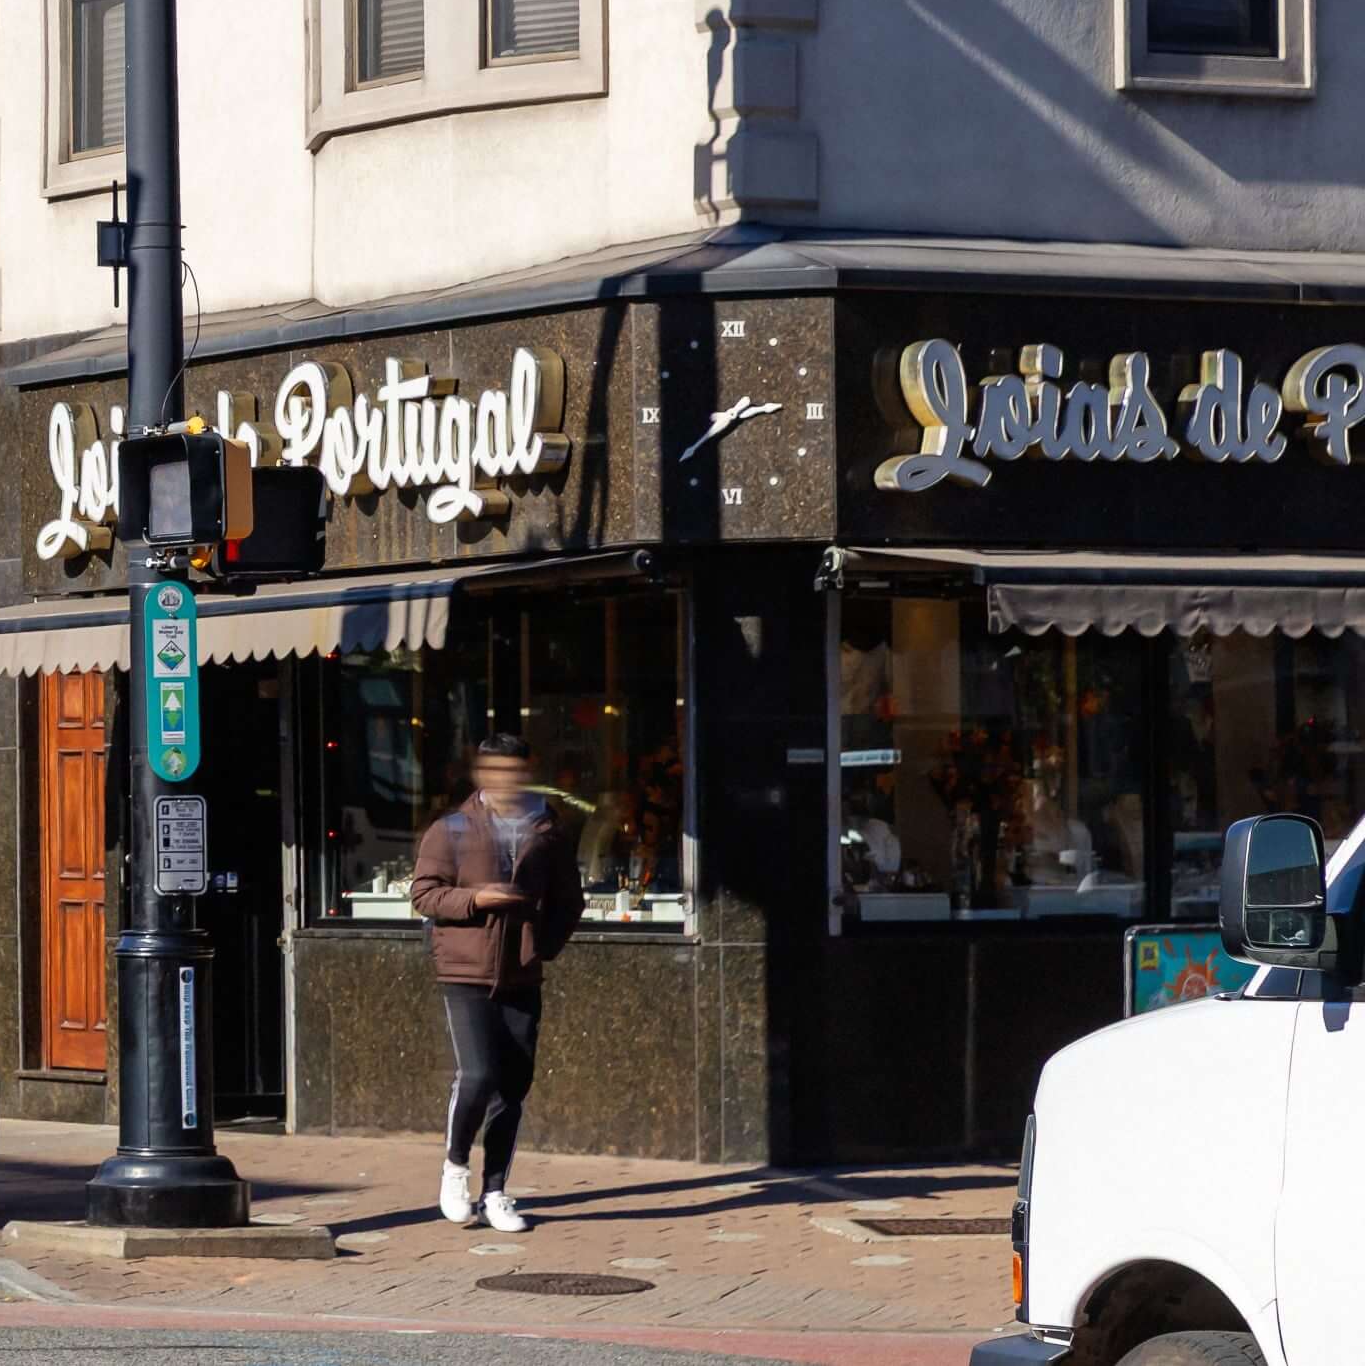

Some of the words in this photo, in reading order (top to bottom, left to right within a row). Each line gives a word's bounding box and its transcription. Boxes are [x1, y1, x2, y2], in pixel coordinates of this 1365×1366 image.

[721, 320, 746, 337] XII
[640, 408, 661, 424] IX
[806, 402, 824, 420] III
[875, 338, 1180, 491] Joias
[1181, 347, 1288, 463] de
[274, 347, 544, 524] Portugal
[722, 488, 743, 505] VI
